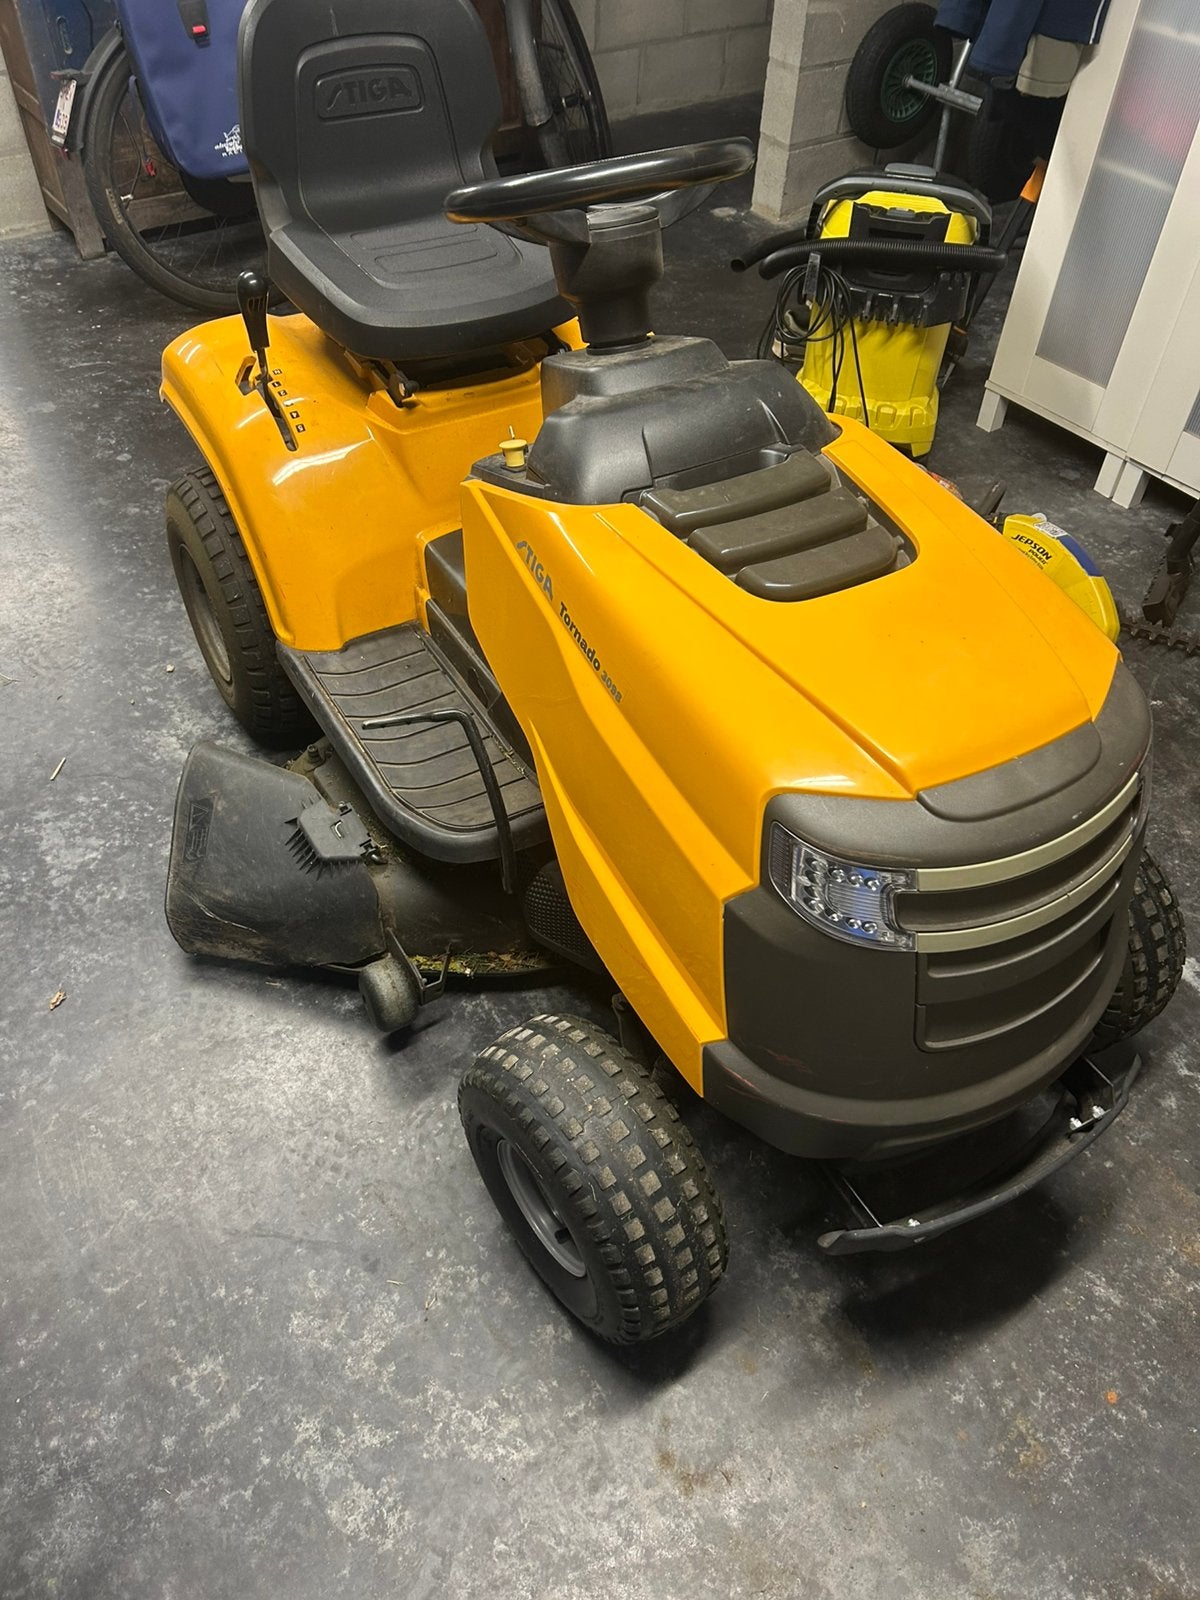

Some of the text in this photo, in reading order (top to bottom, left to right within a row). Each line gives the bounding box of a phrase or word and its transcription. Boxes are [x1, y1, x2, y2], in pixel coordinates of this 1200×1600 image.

[326, 77, 413, 111] STIGA
[1011, 534, 1053, 561] JEPSON
[516, 540, 623, 703] STIGA Tornado 3098
